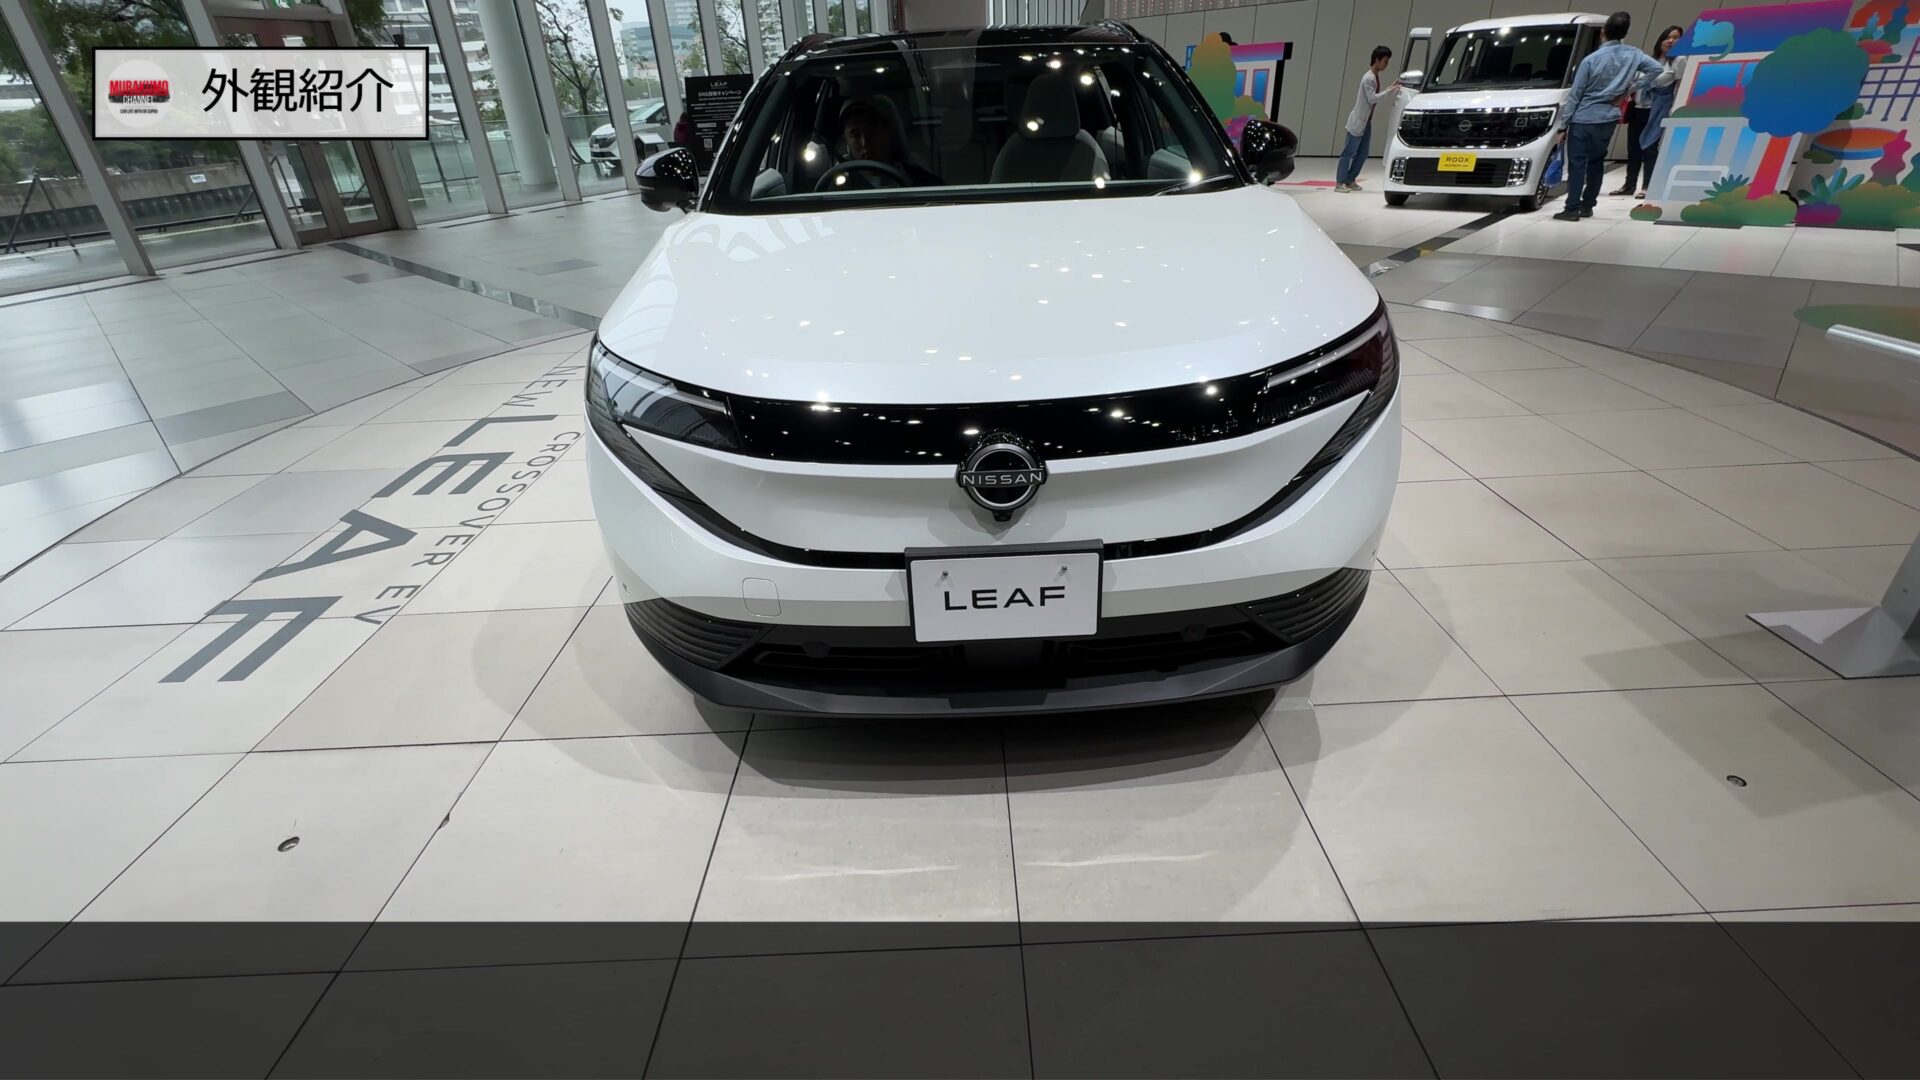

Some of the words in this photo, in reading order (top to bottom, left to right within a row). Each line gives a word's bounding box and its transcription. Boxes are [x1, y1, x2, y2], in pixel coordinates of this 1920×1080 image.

[502, 365, 586, 408] NEW
[412, 430, 581, 567] CROSSOVER
[962, 471, 1042, 485] NISSAN
[158, 414, 559, 683] LEAF
[353, 584, 422, 625] EV
[944, 586, 1065, 611] LEAF
